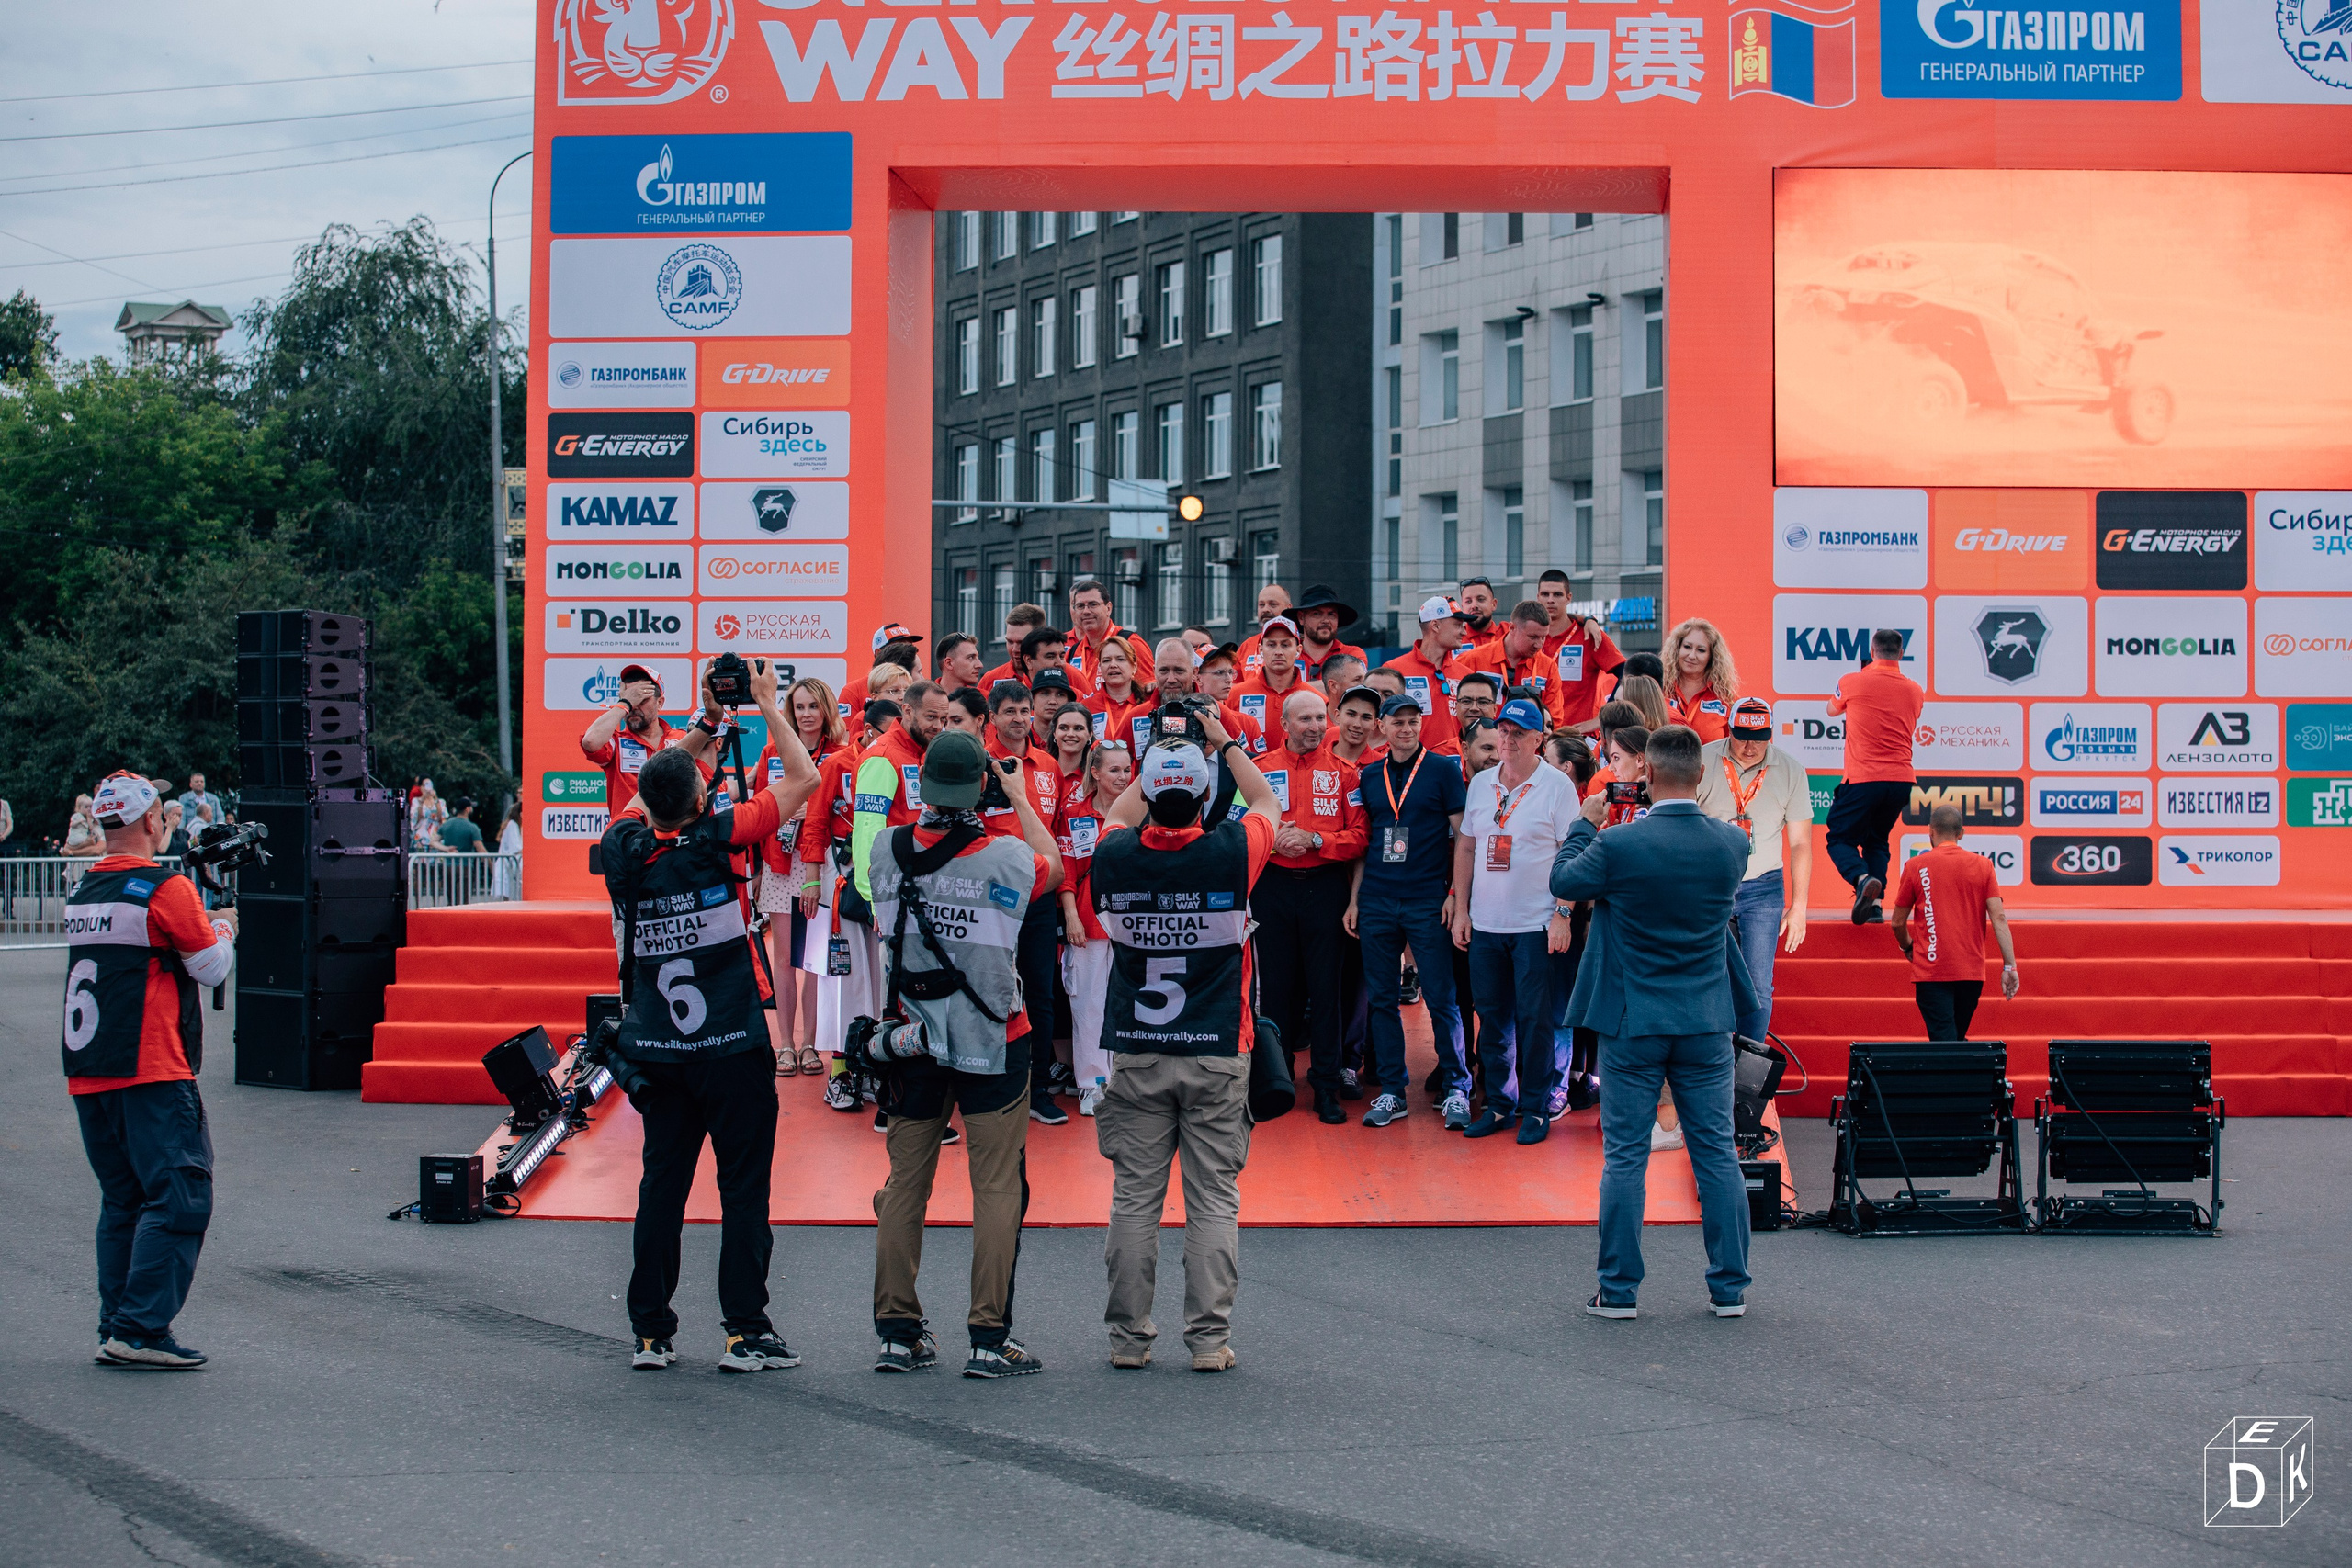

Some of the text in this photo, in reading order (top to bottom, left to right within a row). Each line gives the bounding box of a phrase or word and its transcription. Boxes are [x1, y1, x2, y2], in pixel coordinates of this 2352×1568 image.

[1987, 11, 2145, 51] ГАЗПРОМ
[1051, 11, 1705, 104] 丝绸之路拉力赛
[2299, 41, 2352, 62] CA
[758, 17, 1035, 102] WAY
[1920, 61, 2145, 84] ГЕНЕРАЛЬНЫЙ ПАРТНЕР
[675, 182, 766, 206] ГАЗПРОМ
[637, 211, 766, 225] ГЕНЕРАЛЬНЫЙ ПАРТНЕР
[669, 302, 729, 314] CAMF
[591, 367, 687, 381] ГАЗПРОМБАНК
[723, 417, 813, 440] Сибирь
[760, 438, 827, 456] здесь
[561, 496, 678, 526] KAMAZ
[2269, 508, 2352, 536] Сибир
[1819, 531, 1918, 546] ГАЗПРОМБАНК
[557, 562, 682, 579] MONGOLIA
[742, 561, 840, 575] СОГЛАСИЕ
[581, 608, 681, 634] Delko
[746, 615, 820, 626] РУССКАЯ
[746, 628, 831, 640] МЕХАНИКА
[1786, 627, 1915, 661] KAMZ
[2107, 638, 2236, 656] MONGOLIA
[1940, 726, 2001, 736] РУССКАЯ
[2076, 727, 2137, 743] ГАЗПРОМ
[1940, 737, 2010, 748] МЕХАНИКА
[2077, 745, 2136, 754] ДОБЫЧА
[2166, 753, 2272, 763] ЛЕНЗОЛОТО
[570, 779, 586, 787] РИА
[570, 786, 599, 795] СПОРТ
[865, 795, 886, 805] SILK
[1313, 797, 1339, 807] SILK
[2046, 794, 2142, 809] РОССИЯ 24
[2167, 791, 2243, 814] ИЗВЕСТИЯ
[865, 803, 886, 813] WAY
[1313, 806, 1339, 817] WAY
[220, 837, 241, 850] RONIN
[2063, 845, 2121, 872] 360
[2197, 852, 2273, 862] ТРИКОЛОР
[956, 878, 984, 889] SILK
[670, 891, 695, 904] SILK
[956, 888, 984, 899] WAY
[1175, 892, 1201, 901] SILK
[672, 900, 695, 912] WAY
[1112, 902, 1130, 910] СПОРТ
[1176, 901, 1201, 910] WAY
[1919, 867, 1937, 962] ORGANIZATION
[636, 916, 707, 939] OFFICIAL
[1122, 916, 1209, 931] OFFICIAL
[643, 932, 699, 953] PHOTO
[1132, 932, 1198, 947] PHOTO
[657, 958, 707, 1036] 6
[1134, 956, 1187, 1026] 5
[64, 958, 99, 1051] 6
[1116, 1030, 1219, 1043] www.silkwayrally.com
